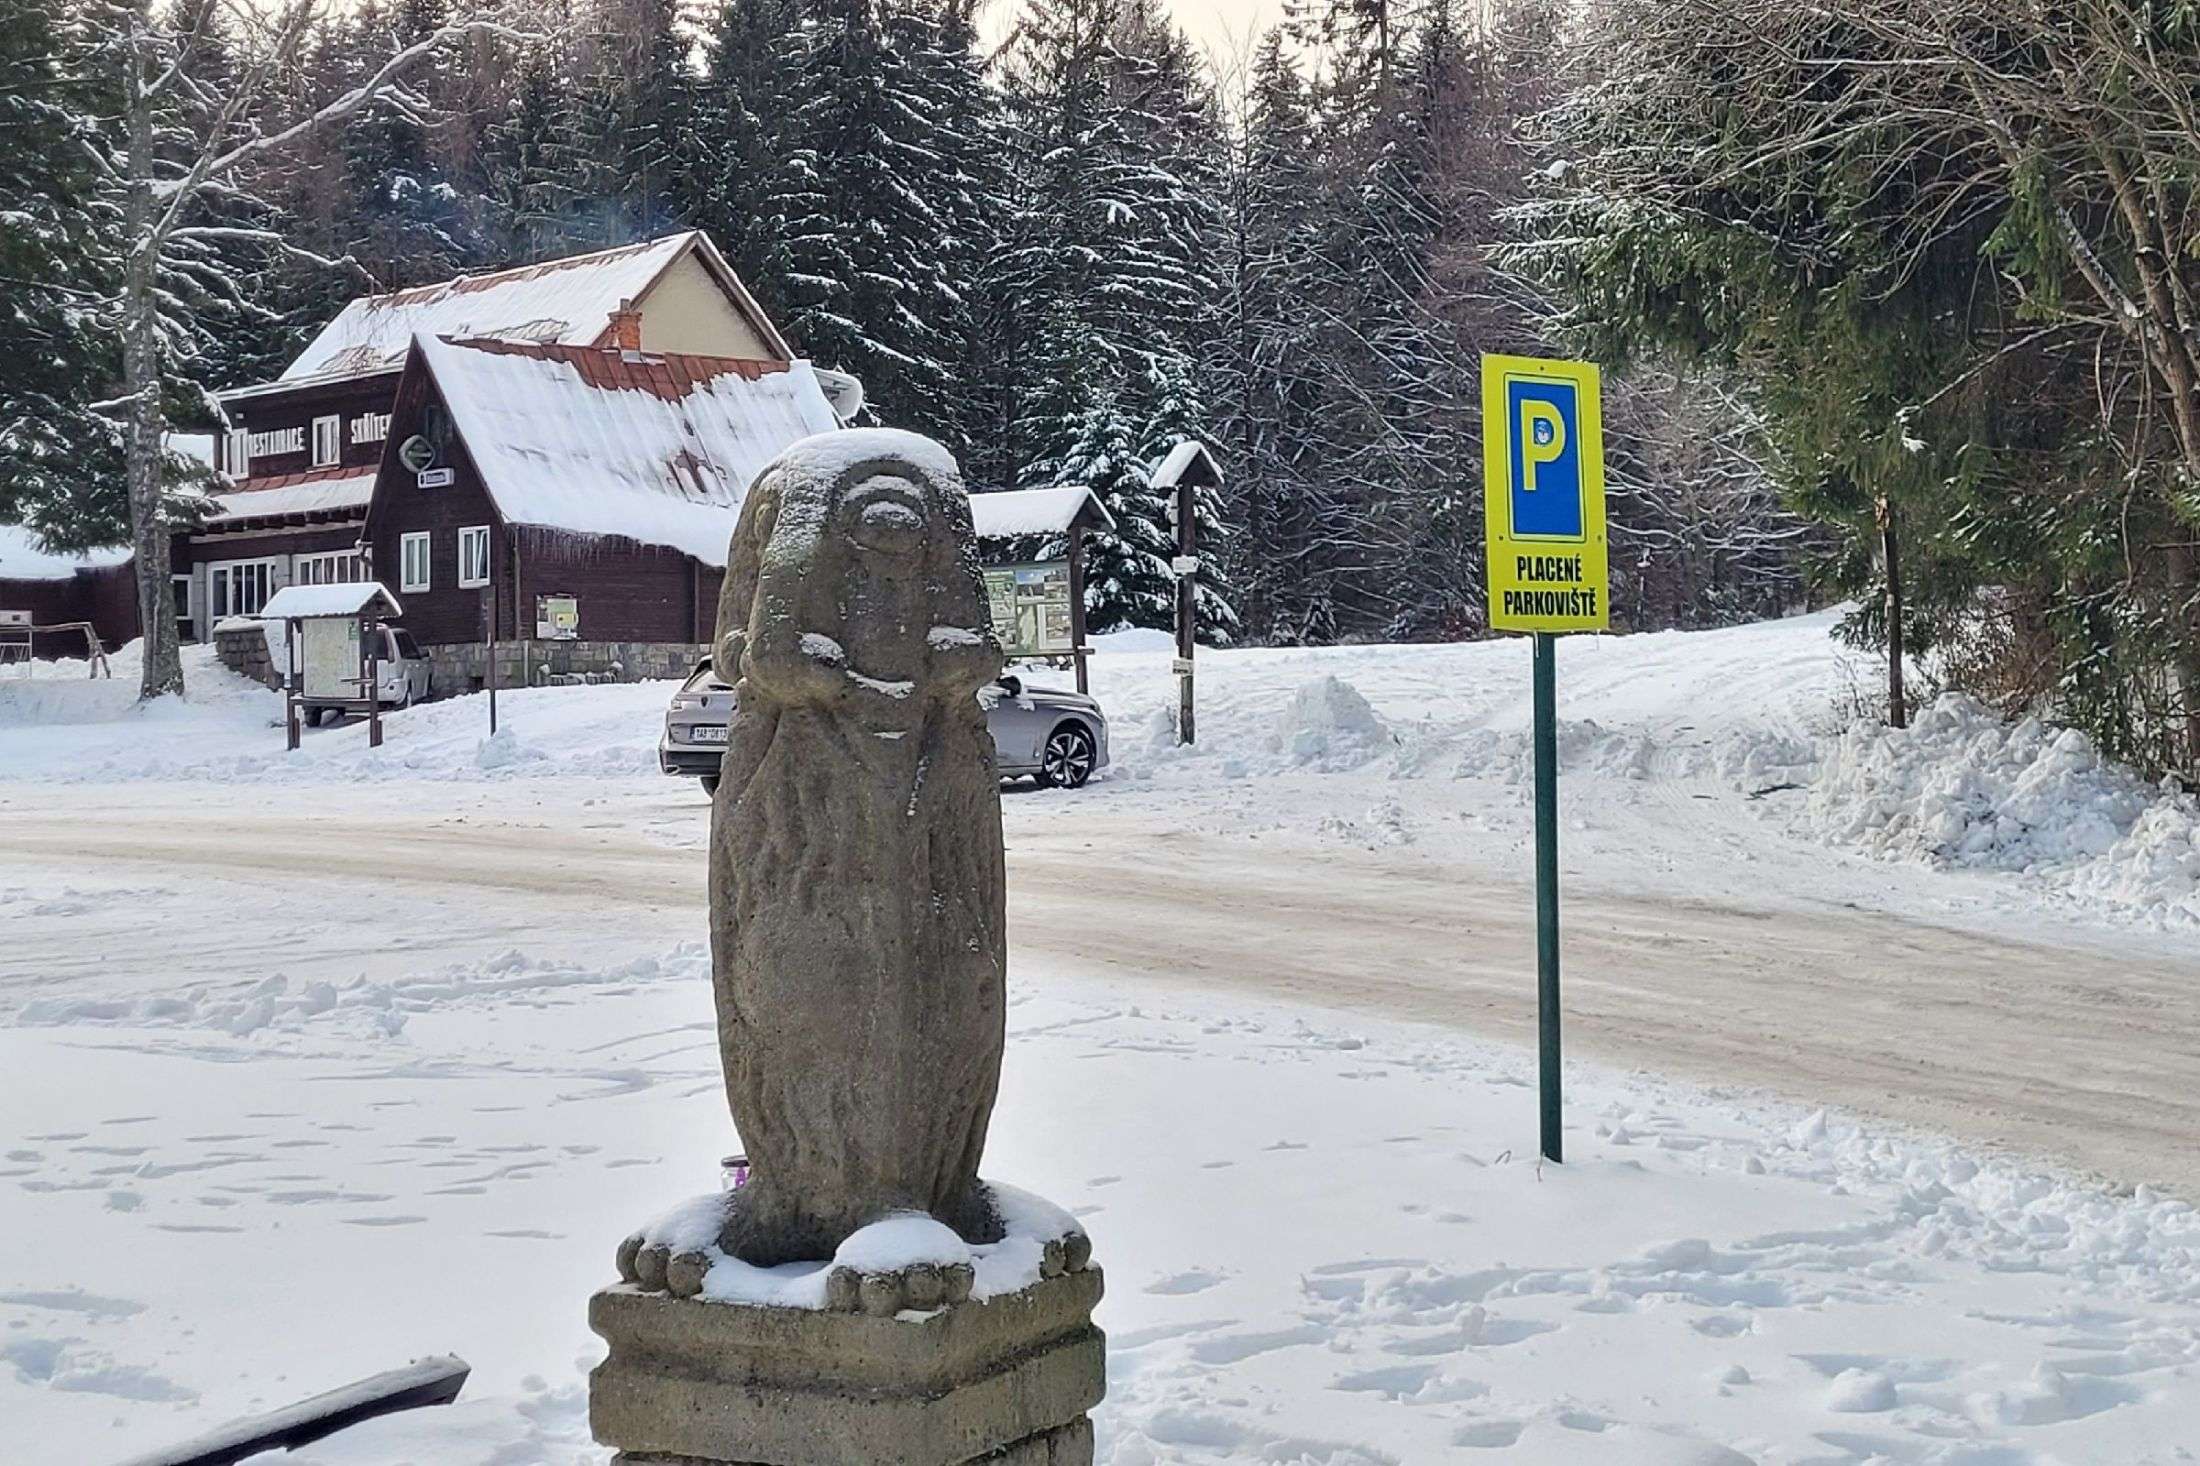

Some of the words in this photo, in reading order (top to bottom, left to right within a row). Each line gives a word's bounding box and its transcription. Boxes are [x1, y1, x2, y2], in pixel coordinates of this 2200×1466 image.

[1520, 399, 1567, 490] P
[1516, 553, 1582, 582] PLACENÉ
[1504, 587, 1597, 617] PARKOVIŠTĚ
